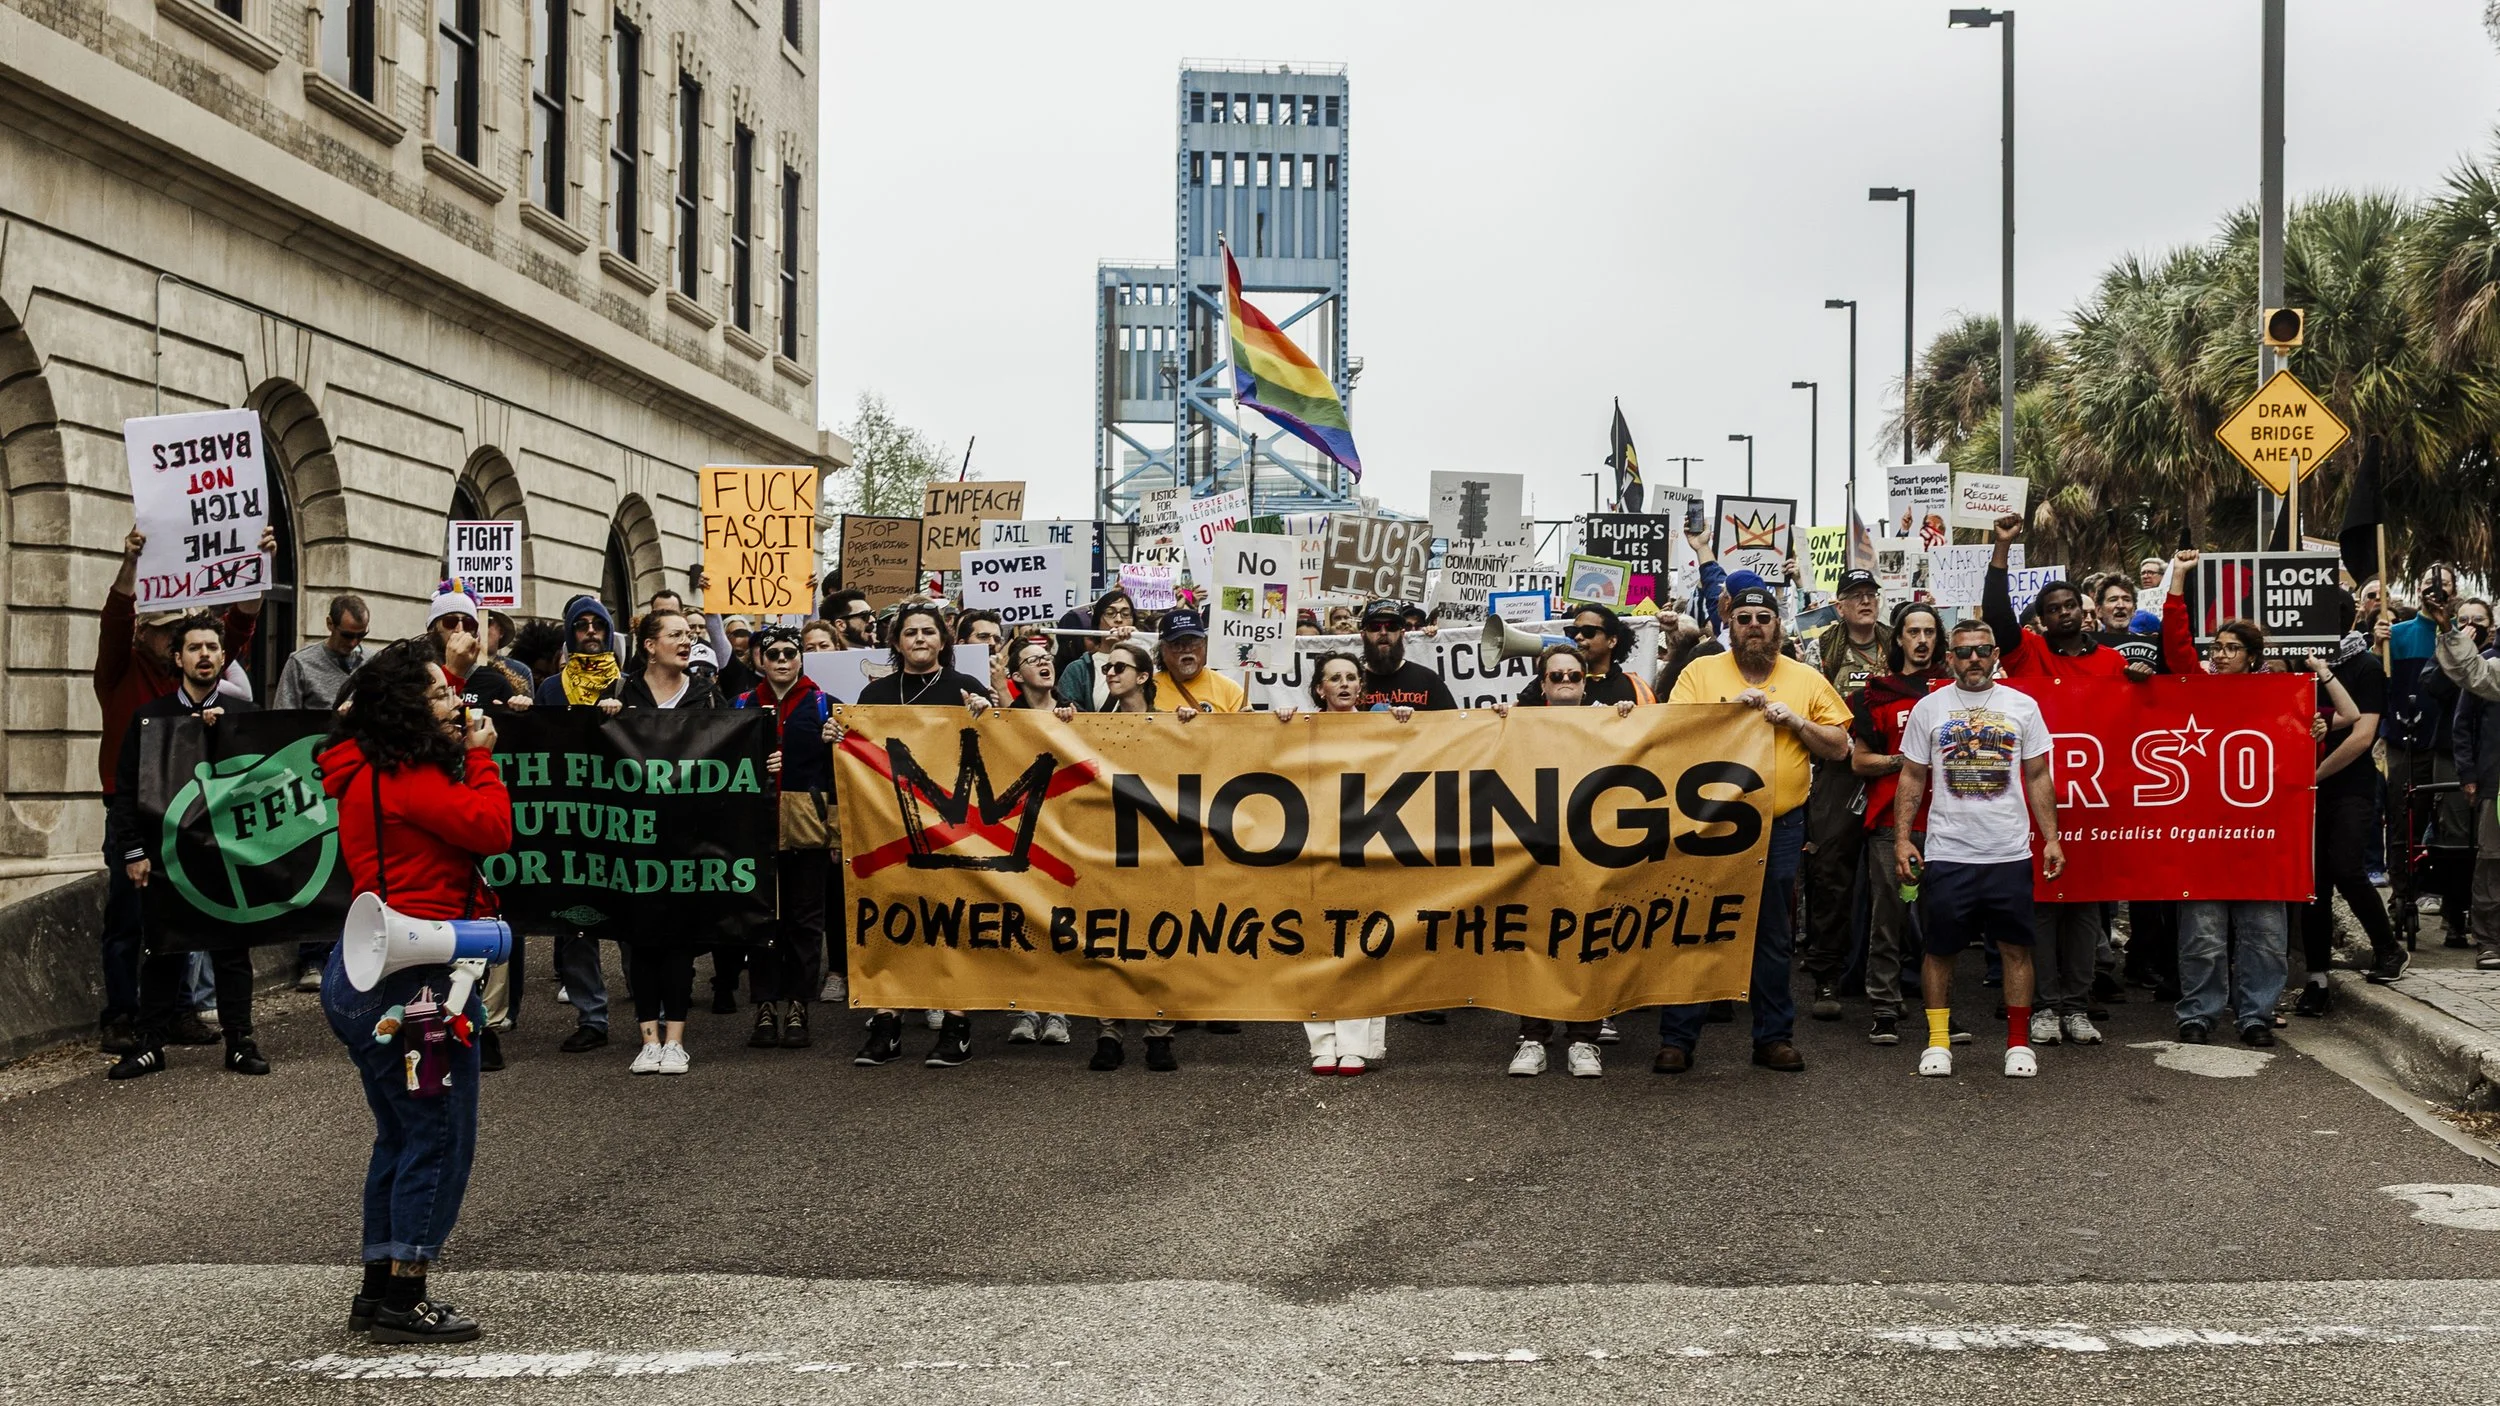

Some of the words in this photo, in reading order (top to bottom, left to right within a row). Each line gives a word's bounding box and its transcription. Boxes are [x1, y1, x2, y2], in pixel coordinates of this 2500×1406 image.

[2258, 403, 2307, 418] DRAW
[2251, 426, 2315, 440] BRIDGE
[152, 430, 252, 472] BABIES
[2252, 447, 2313, 462] AHEAD
[186, 465, 235, 495] NOT
[1920, 473, 1948, 487] people
[713, 471, 814, 513] FUCK
[1151, 489, 1178, 502] JUSTICE
[1663, 491, 1694, 501] TRUMP
[1914, 486, 1929, 496] like
[1963, 487, 2008, 501] REGIME
[190, 487, 263, 526] RICH
[926, 488, 1022, 516] IMPEACH
[1157, 501, 1171, 511] FOR
[1193, 492, 1235, 512] EPSTEIN
[1965, 501, 2013, 514] CHANGE
[1142, 514, 1155, 524] ALL
[1156, 511, 1178, 522] VICTI
[704, 514, 815, 550] FASCIT
[850, 520, 900, 539] STOP
[994, 524, 1030, 543] JAIL
[1048, 525, 1074, 544] THE
[1589, 517, 1665, 540] TRUMP'S
[184, 528, 246, 563] THE
[457, 526, 514, 551] FIGHT
[847, 540, 910, 554] PRETENDING
[1330, 516, 1431, 572] FUCK
[1807, 532, 1846, 550] ON'T
[1612, 540, 1649, 557] LIES
[457, 556, 513, 571] TRUMP'S
[741, 551, 790, 578] NOT
[846, 556, 871, 568] YOUR
[971, 555, 1048, 576] POWER
[1238, 551, 1277, 576] No
[1445, 555, 1508, 573] COMMUNITY
[1631, 558, 1662, 574] TER
[1933, 549, 1976, 570] WAR
[853, 567, 875, 579] IS
[1150, 566, 1171, 577] JUST
[1754, 563, 1779, 576] 1776
[2266, 567, 2334, 586] LOCK
[846, 581, 914, 596] PTRIOTISM!
[1331, 563, 1424, 601] ICE
[1452, 571, 1498, 588] CONTROL
[1509, 575, 1565, 596] EACH
[2008, 570, 2058, 592] DERA
[727, 575, 792, 609] KIDS
[979, 581, 1000, 593] TO
[1013, 586, 1042, 599] THE
[1460, 588, 1487, 602] NOW!
[2266, 589, 2313, 606] HIM
[1134, 598, 1176, 609] IGHTS
[996, 603, 1054, 623] OPLE
[2267, 610, 2303, 628] UP.
[1224, 619, 1282, 642] Kings!
[2120, 647, 2147, 656] ATION
[2263, 647, 2282, 656] OR
[2283, 646, 2326, 656] PRISON
[1850, 672, 1870, 680] N7
[1390, 688, 1428, 705] Abroad
[493, 752, 551, 788] TH
[563, 752, 761, 794] FLORIDA
[2048, 729, 2274, 808] RSO
[512, 802, 657, 844] UTURE
[1112, 772, 1310, 868] NO
[1339, 761, 1766, 869] KINGS
[2053, 828, 2083, 841] oad
[2090, 825, 2162, 841] Socialist
[2170, 825, 2276, 843] Organization
[483, 850, 551, 887] OR
[561, 850, 757, 894] LEADERS
[856, 896, 1037, 952] POWER
[1049, 902, 1305, 962] BELONGS
[1324, 909, 1395, 960] TO
[1416, 904, 1529, 956] THE
[1547, 893, 1746, 964] PEOPLE
